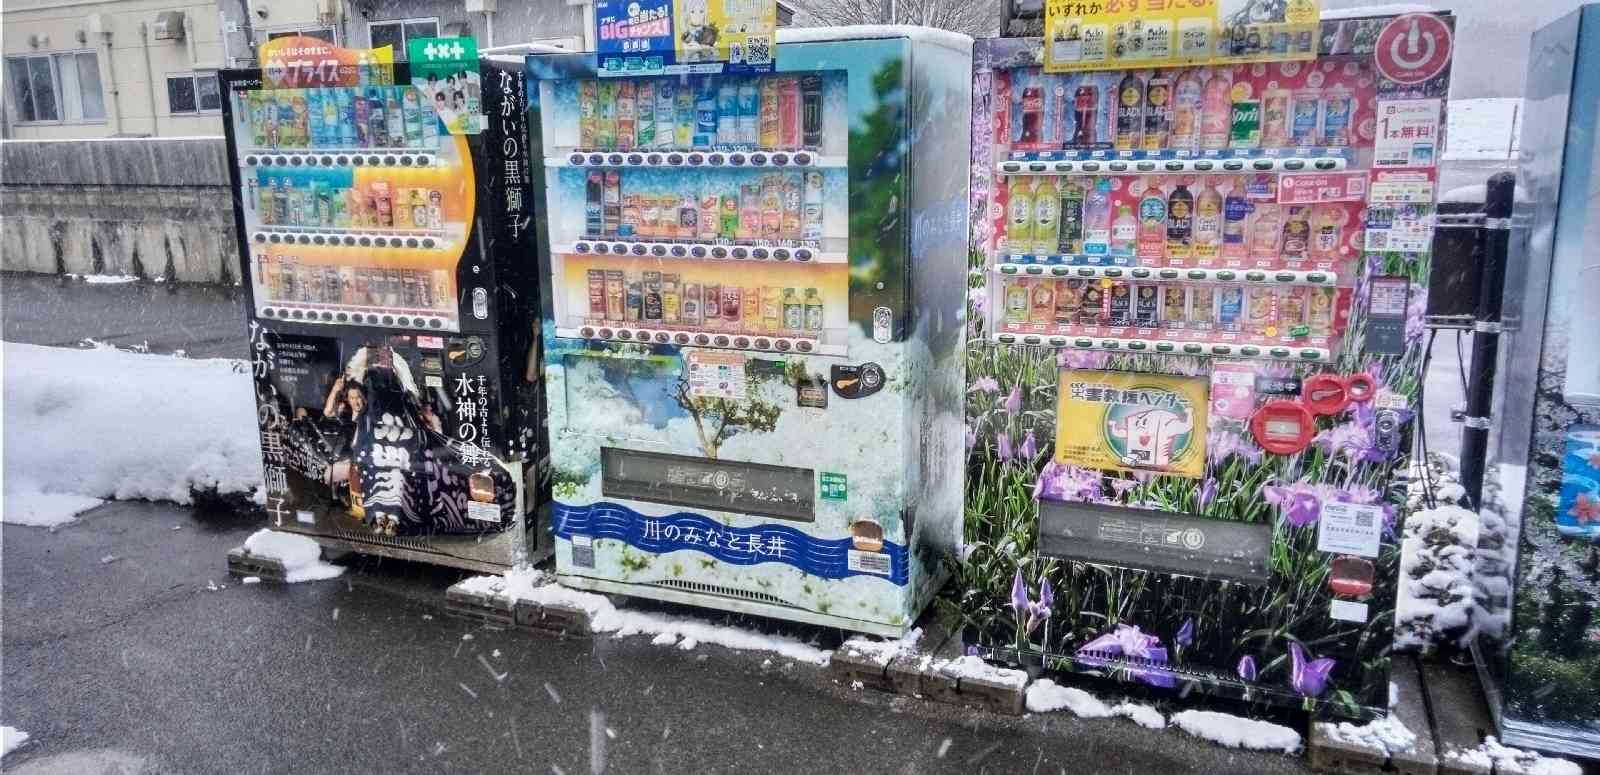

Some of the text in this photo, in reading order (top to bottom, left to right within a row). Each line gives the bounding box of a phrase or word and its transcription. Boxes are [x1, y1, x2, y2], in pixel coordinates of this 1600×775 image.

[1049, 2, 1103, 17] いずれか
[1380, 118, 1435, 139] 1本無料!
[499, 70, 522, 238] ながいの黒獅子
[1071, 382, 1190, 407] 災害救援ベンダー
[249, 320, 290, 527] ながいの黒獅子
[455, 372, 479, 467] 水神の舞
[643, 519, 786, 558] 川のみなと長井
